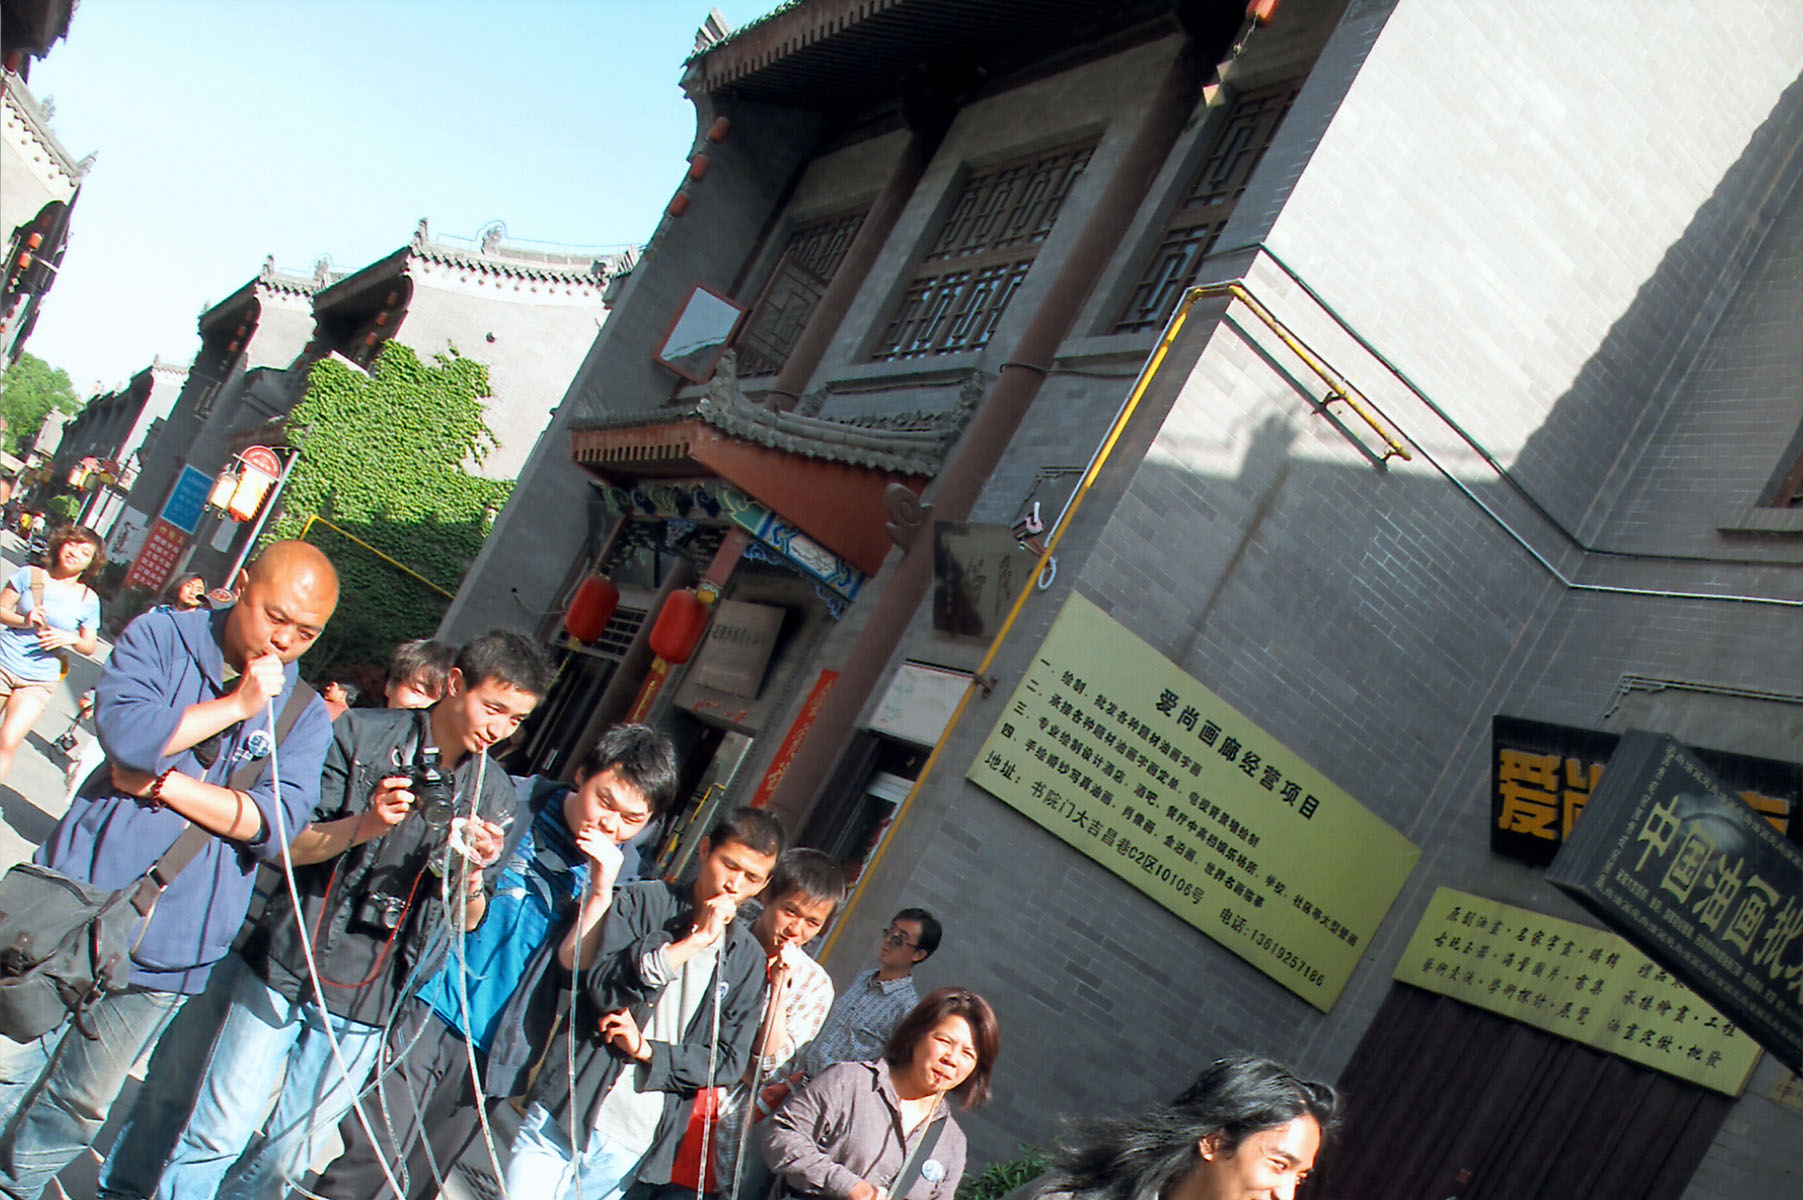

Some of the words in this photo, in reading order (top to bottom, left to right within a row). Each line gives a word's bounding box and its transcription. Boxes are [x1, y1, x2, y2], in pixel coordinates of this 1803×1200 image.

[1155, 687, 1320, 820] 爱尚画廊经营项目
[1634, 795, 1803, 1004] 中国油画批
